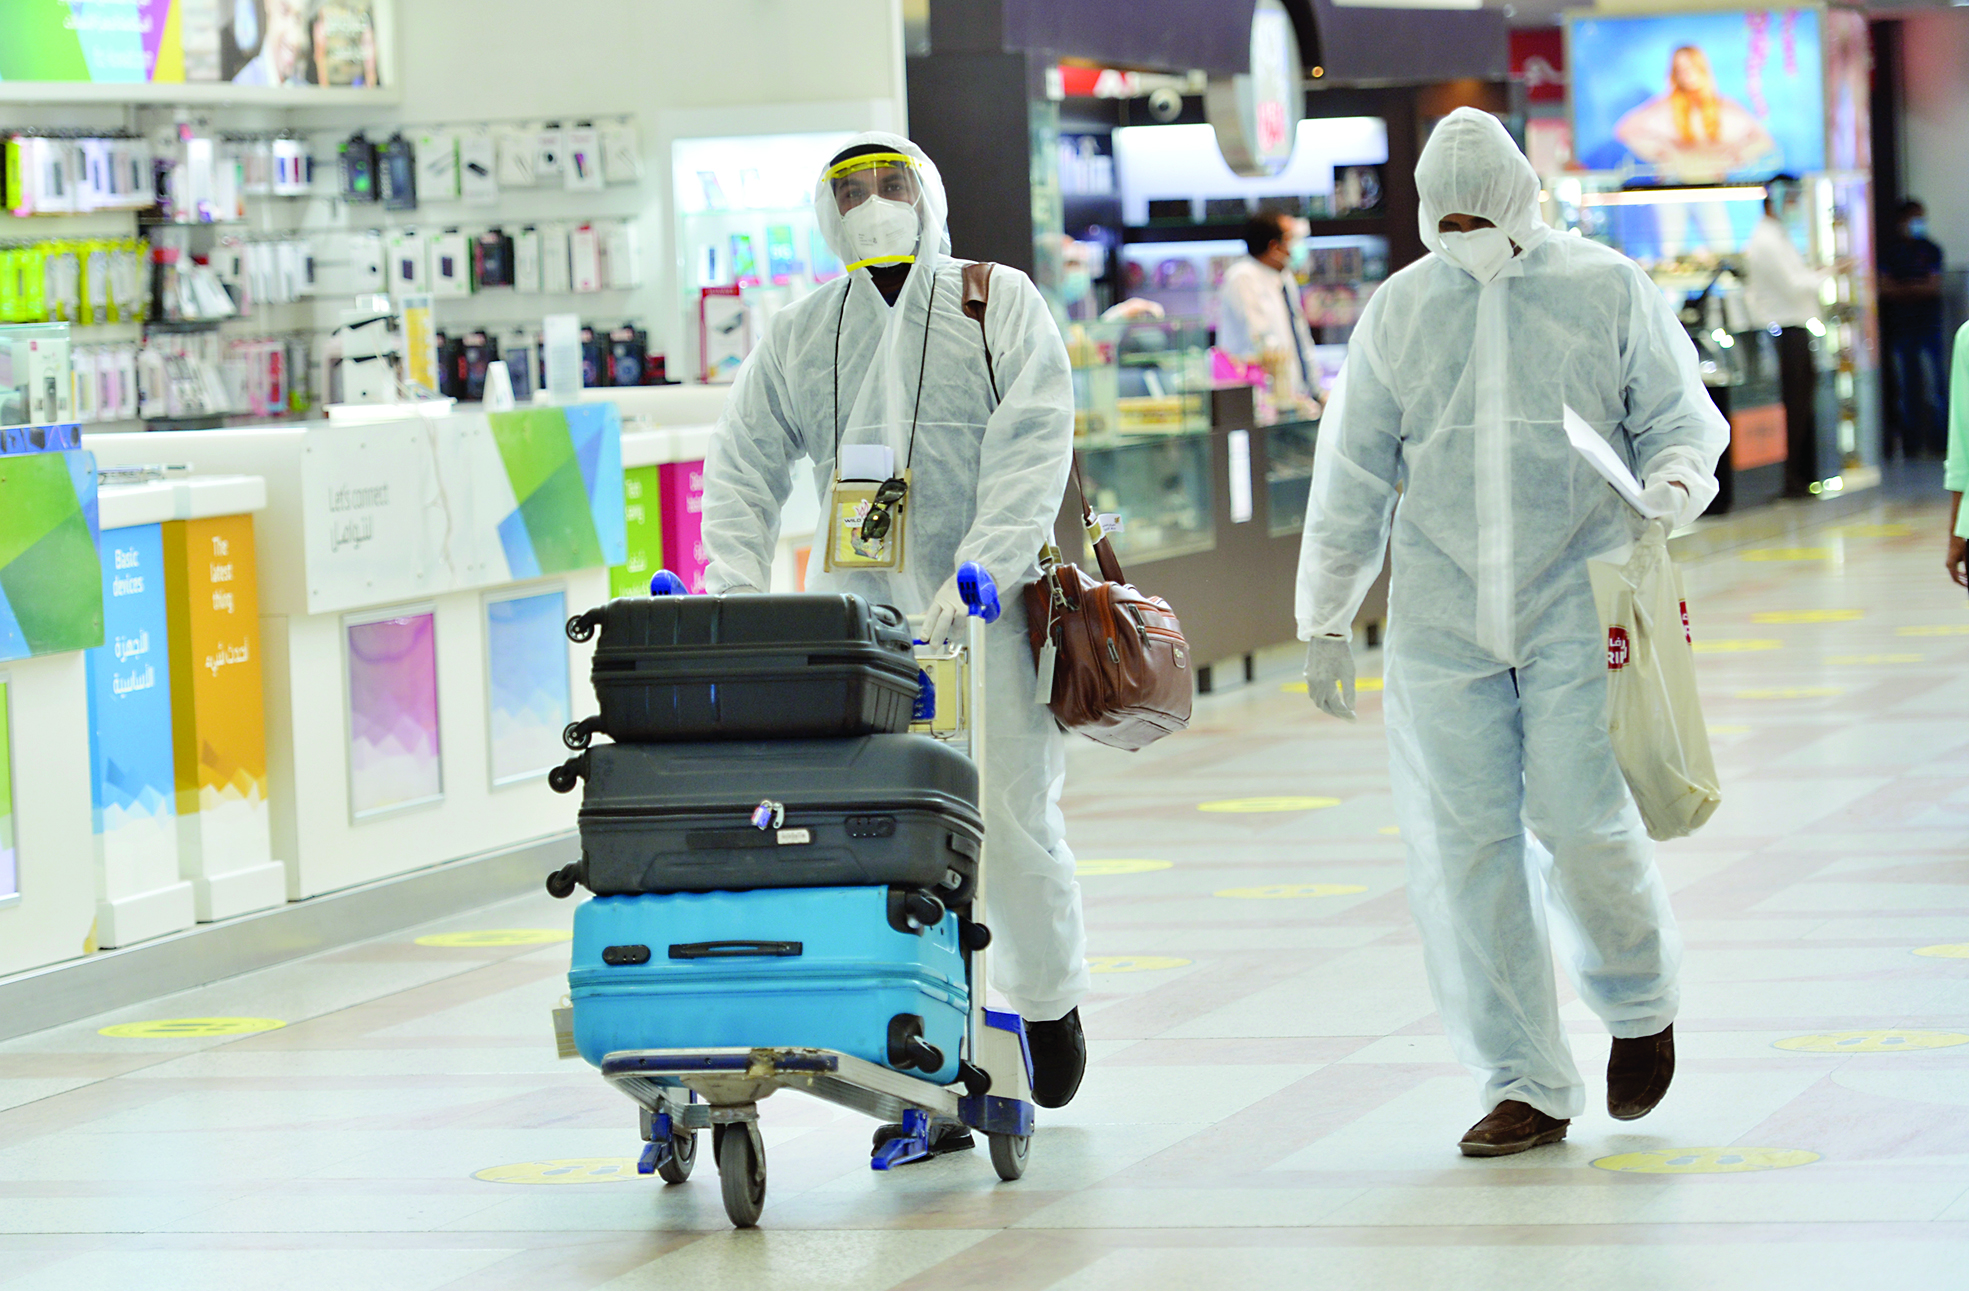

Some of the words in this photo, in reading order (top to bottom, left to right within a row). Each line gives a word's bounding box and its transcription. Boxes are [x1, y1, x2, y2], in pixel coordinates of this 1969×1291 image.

[352, 482, 389, 509] connect
[115, 546, 139, 570] Basic
[211, 536, 229, 556] The
[112, 573, 144, 597] devices
[210, 562, 234, 583] latest
[212, 588, 234, 614] thing
[114, 627, 148, 663] الأجهزة
[113, 663, 155, 699] الأساسية
